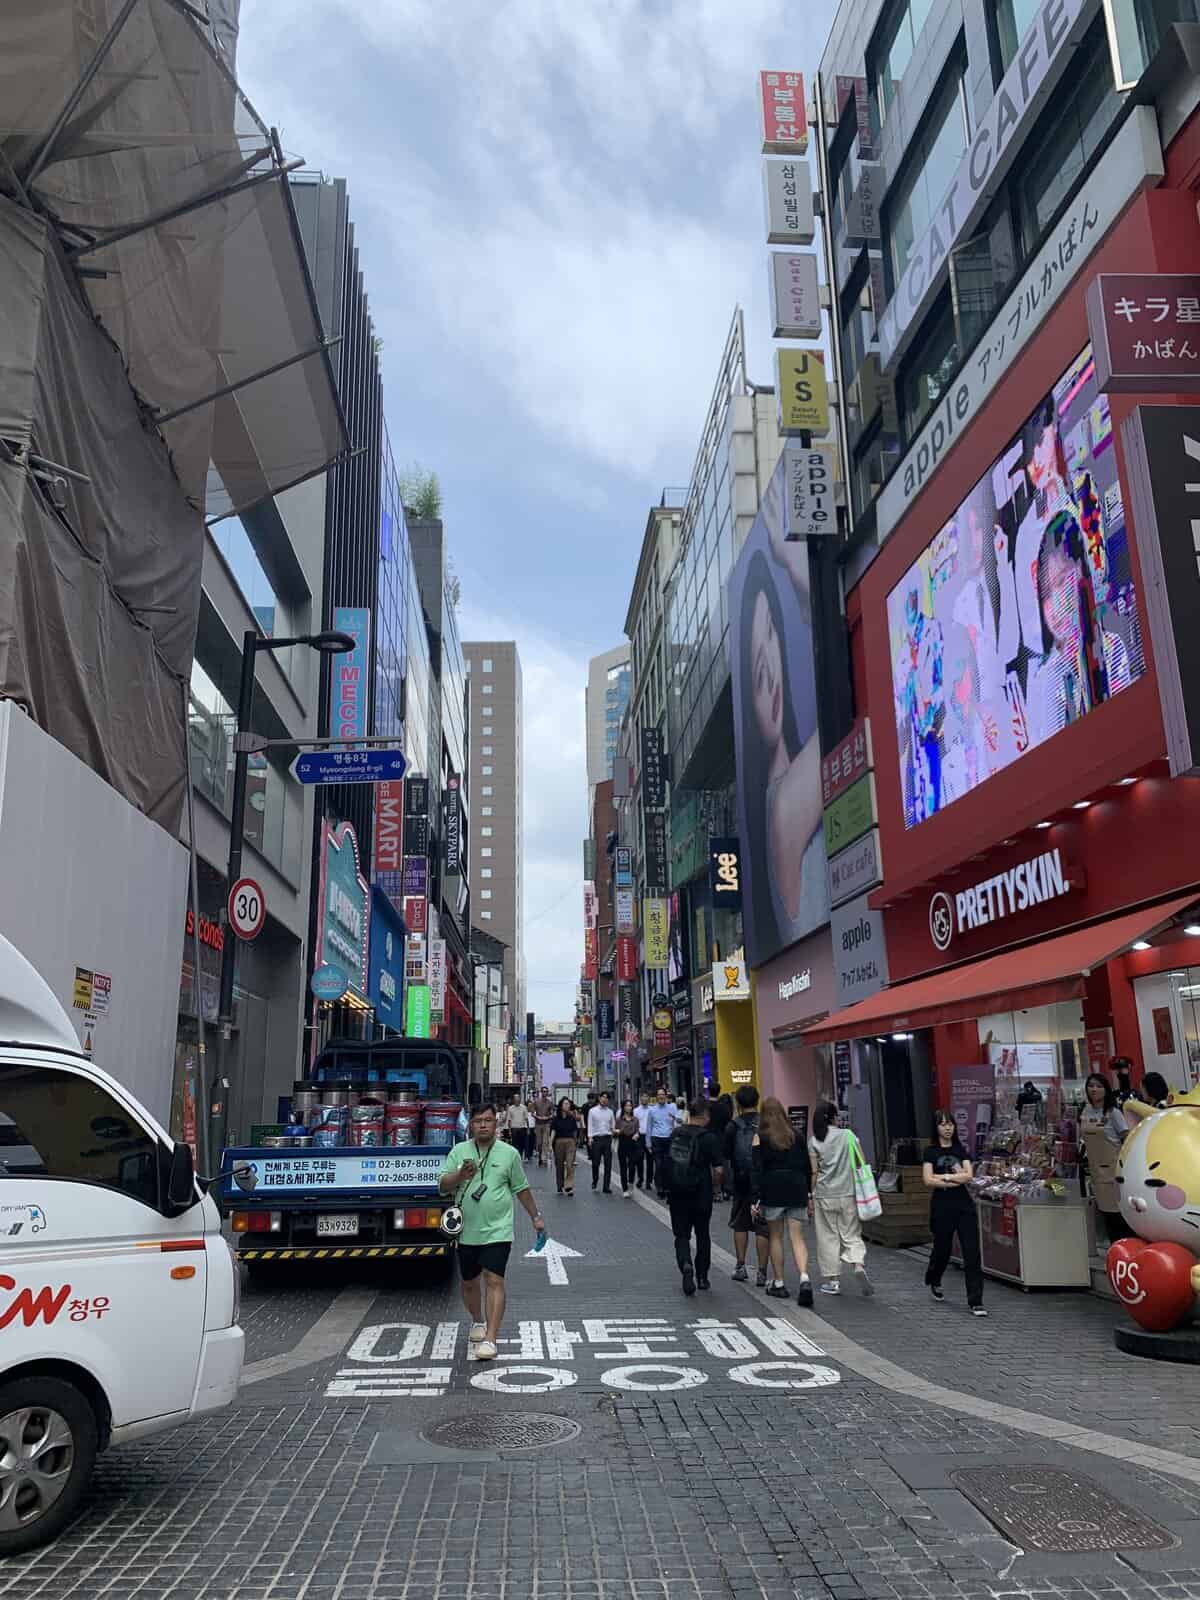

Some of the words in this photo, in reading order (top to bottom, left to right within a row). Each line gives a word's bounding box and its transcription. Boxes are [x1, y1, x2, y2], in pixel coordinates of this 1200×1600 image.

[782, 164, 799, 230] 삼성빌딩
[906, 178, 962, 308] CAT
[1114, 297, 1200, 323] キラ星
[902, 382, 972, 498] apple
[976, 201, 1099, 387] アップルかばん
[1133, 338, 1198, 359] かばん
[808, 454, 828, 522] apple
[447, 815, 459, 869] SKYPARK
[715, 852, 739, 892] Lee
[237, 893, 258, 922] 30
[842, 917, 872, 952] apple
[265, 1161, 291, 1172] 전세계
[293, 1161, 310, 1171] 모든
[379, 1159, 440, 1169] 02-867-8000
[1114, 1258, 1140, 1295] PS
